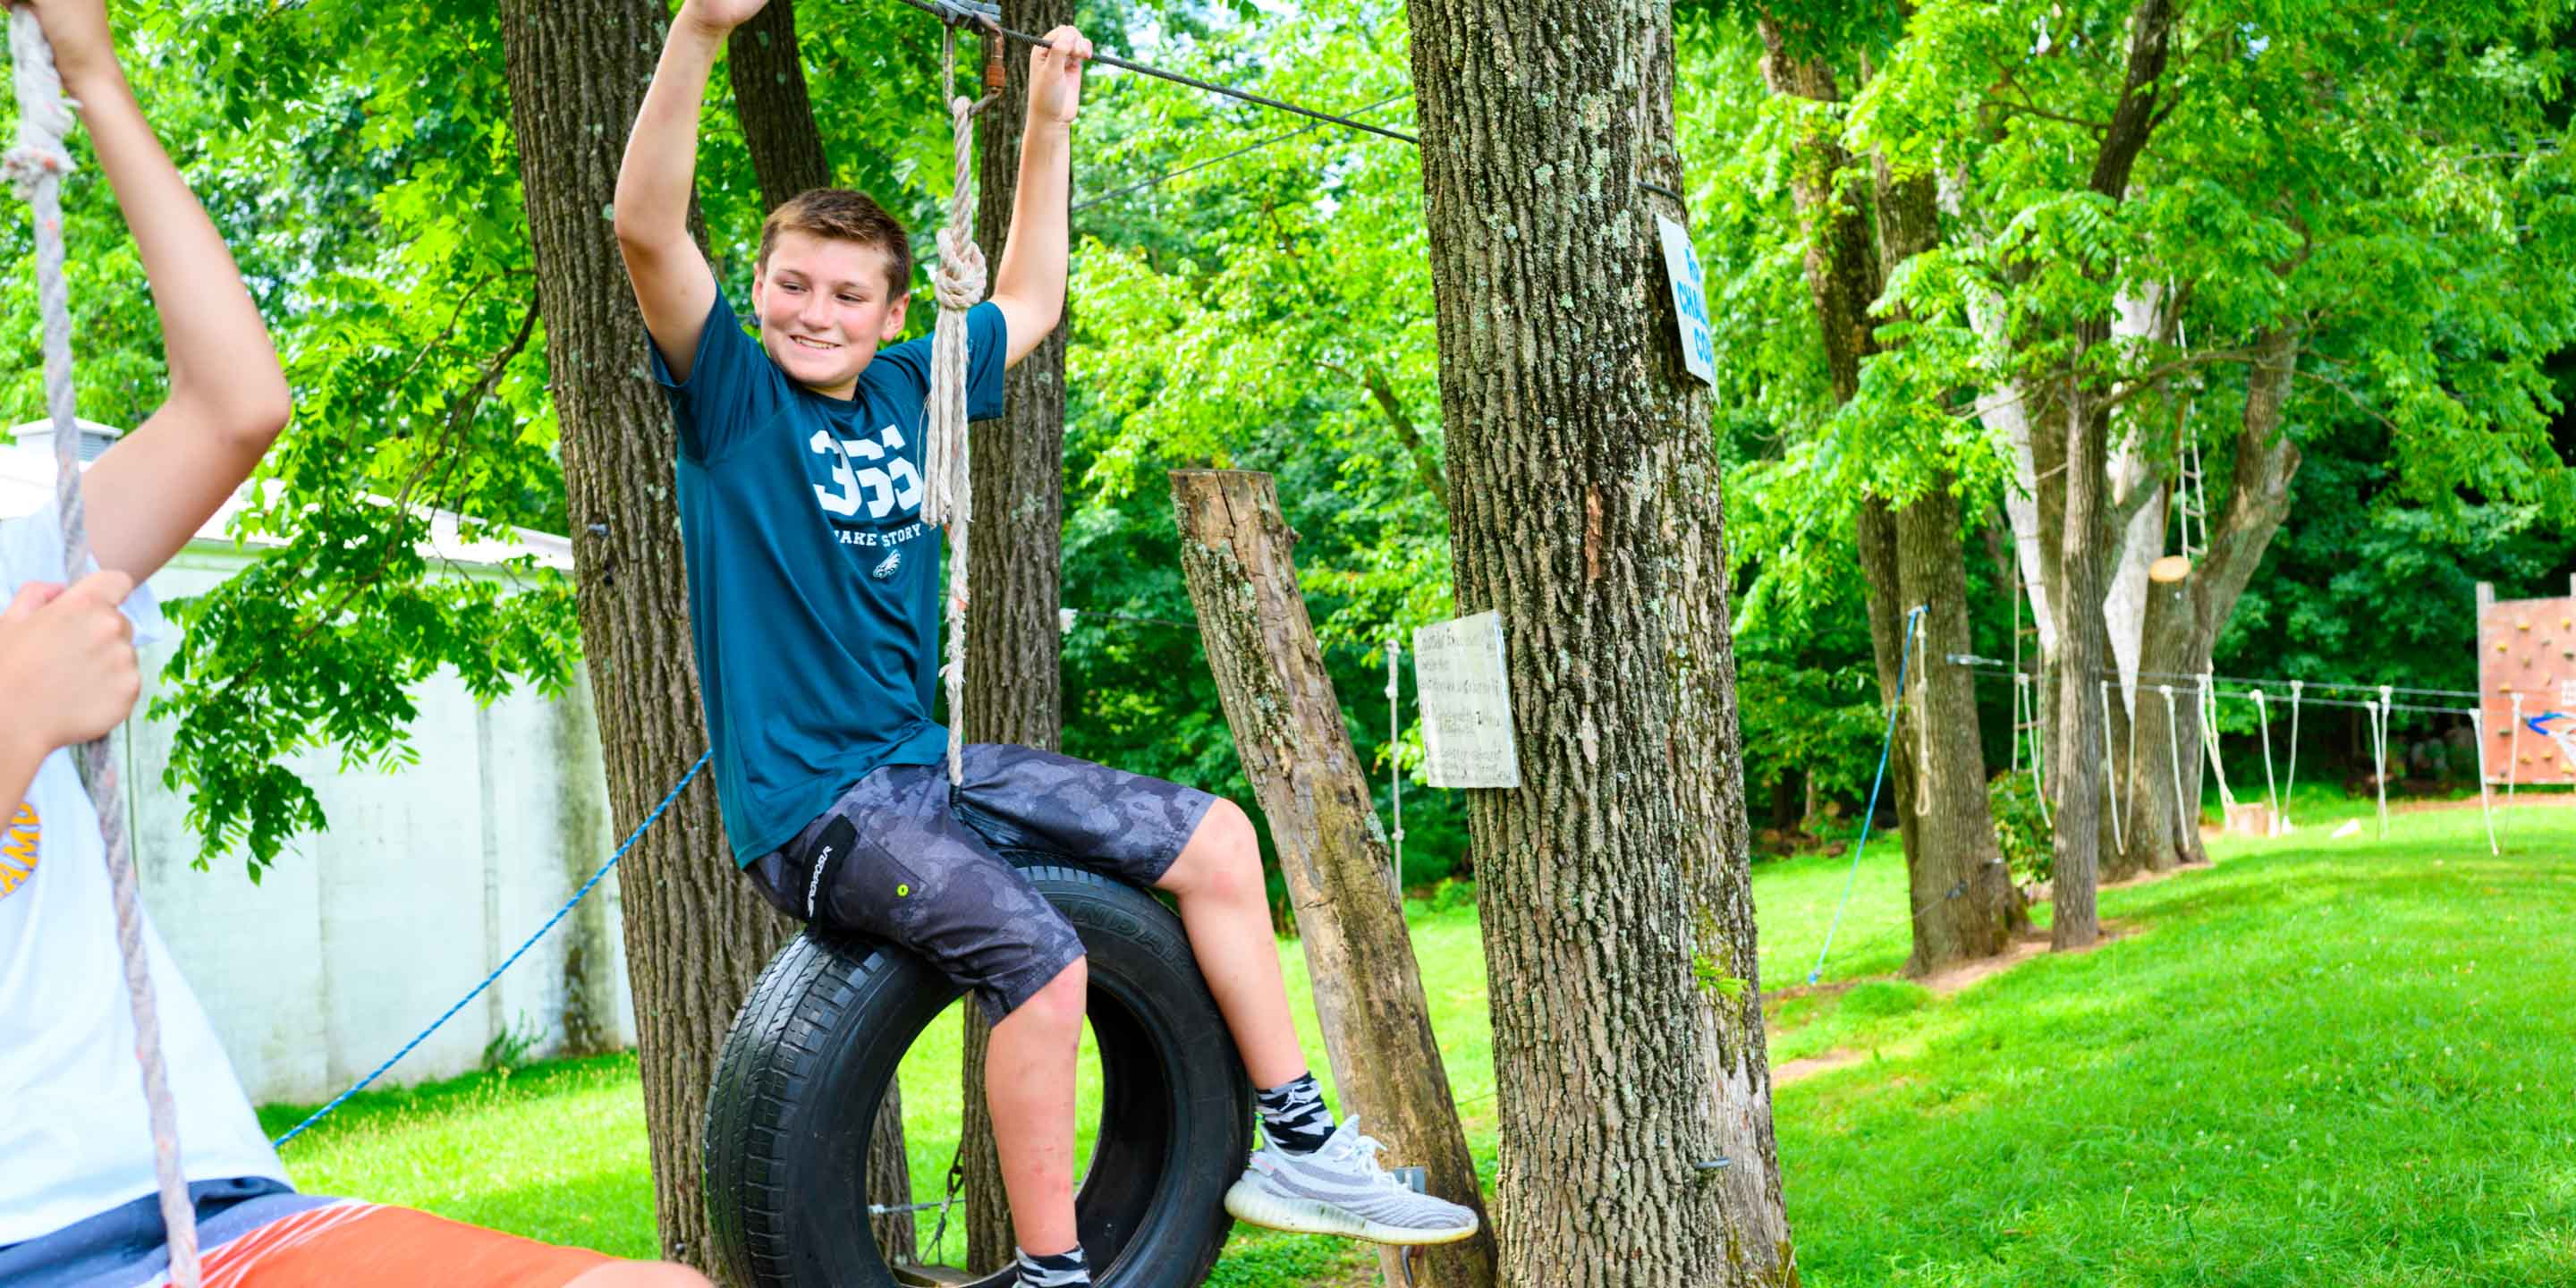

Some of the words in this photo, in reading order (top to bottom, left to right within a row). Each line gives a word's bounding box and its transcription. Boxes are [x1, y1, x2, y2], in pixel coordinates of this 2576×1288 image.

[834, 530, 877, 547] AKE
[881, 522, 921, 547] STORY
[0, 801, 41, 898] AMP
